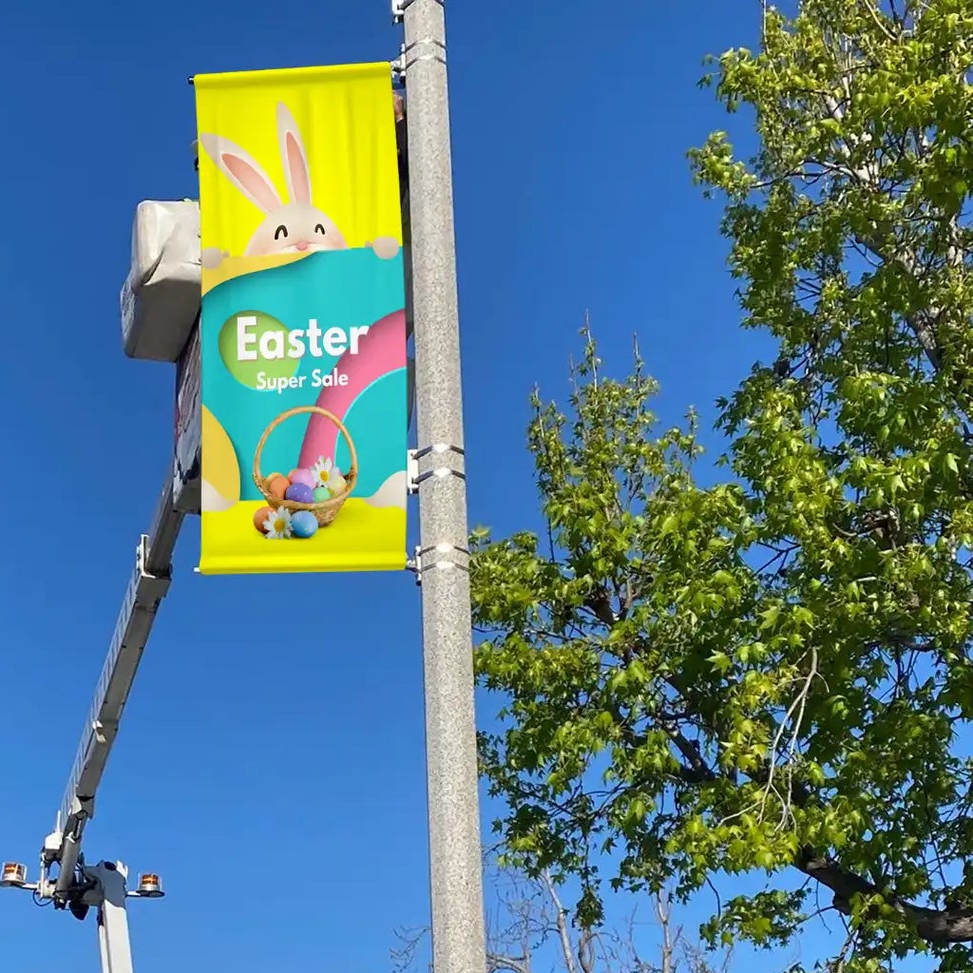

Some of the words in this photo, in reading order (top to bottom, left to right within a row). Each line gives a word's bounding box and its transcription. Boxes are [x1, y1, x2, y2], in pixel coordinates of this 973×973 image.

[236, 316, 369, 360] Easter
[255, 371, 307, 393] Super
[311, 368, 349, 387] Sale
